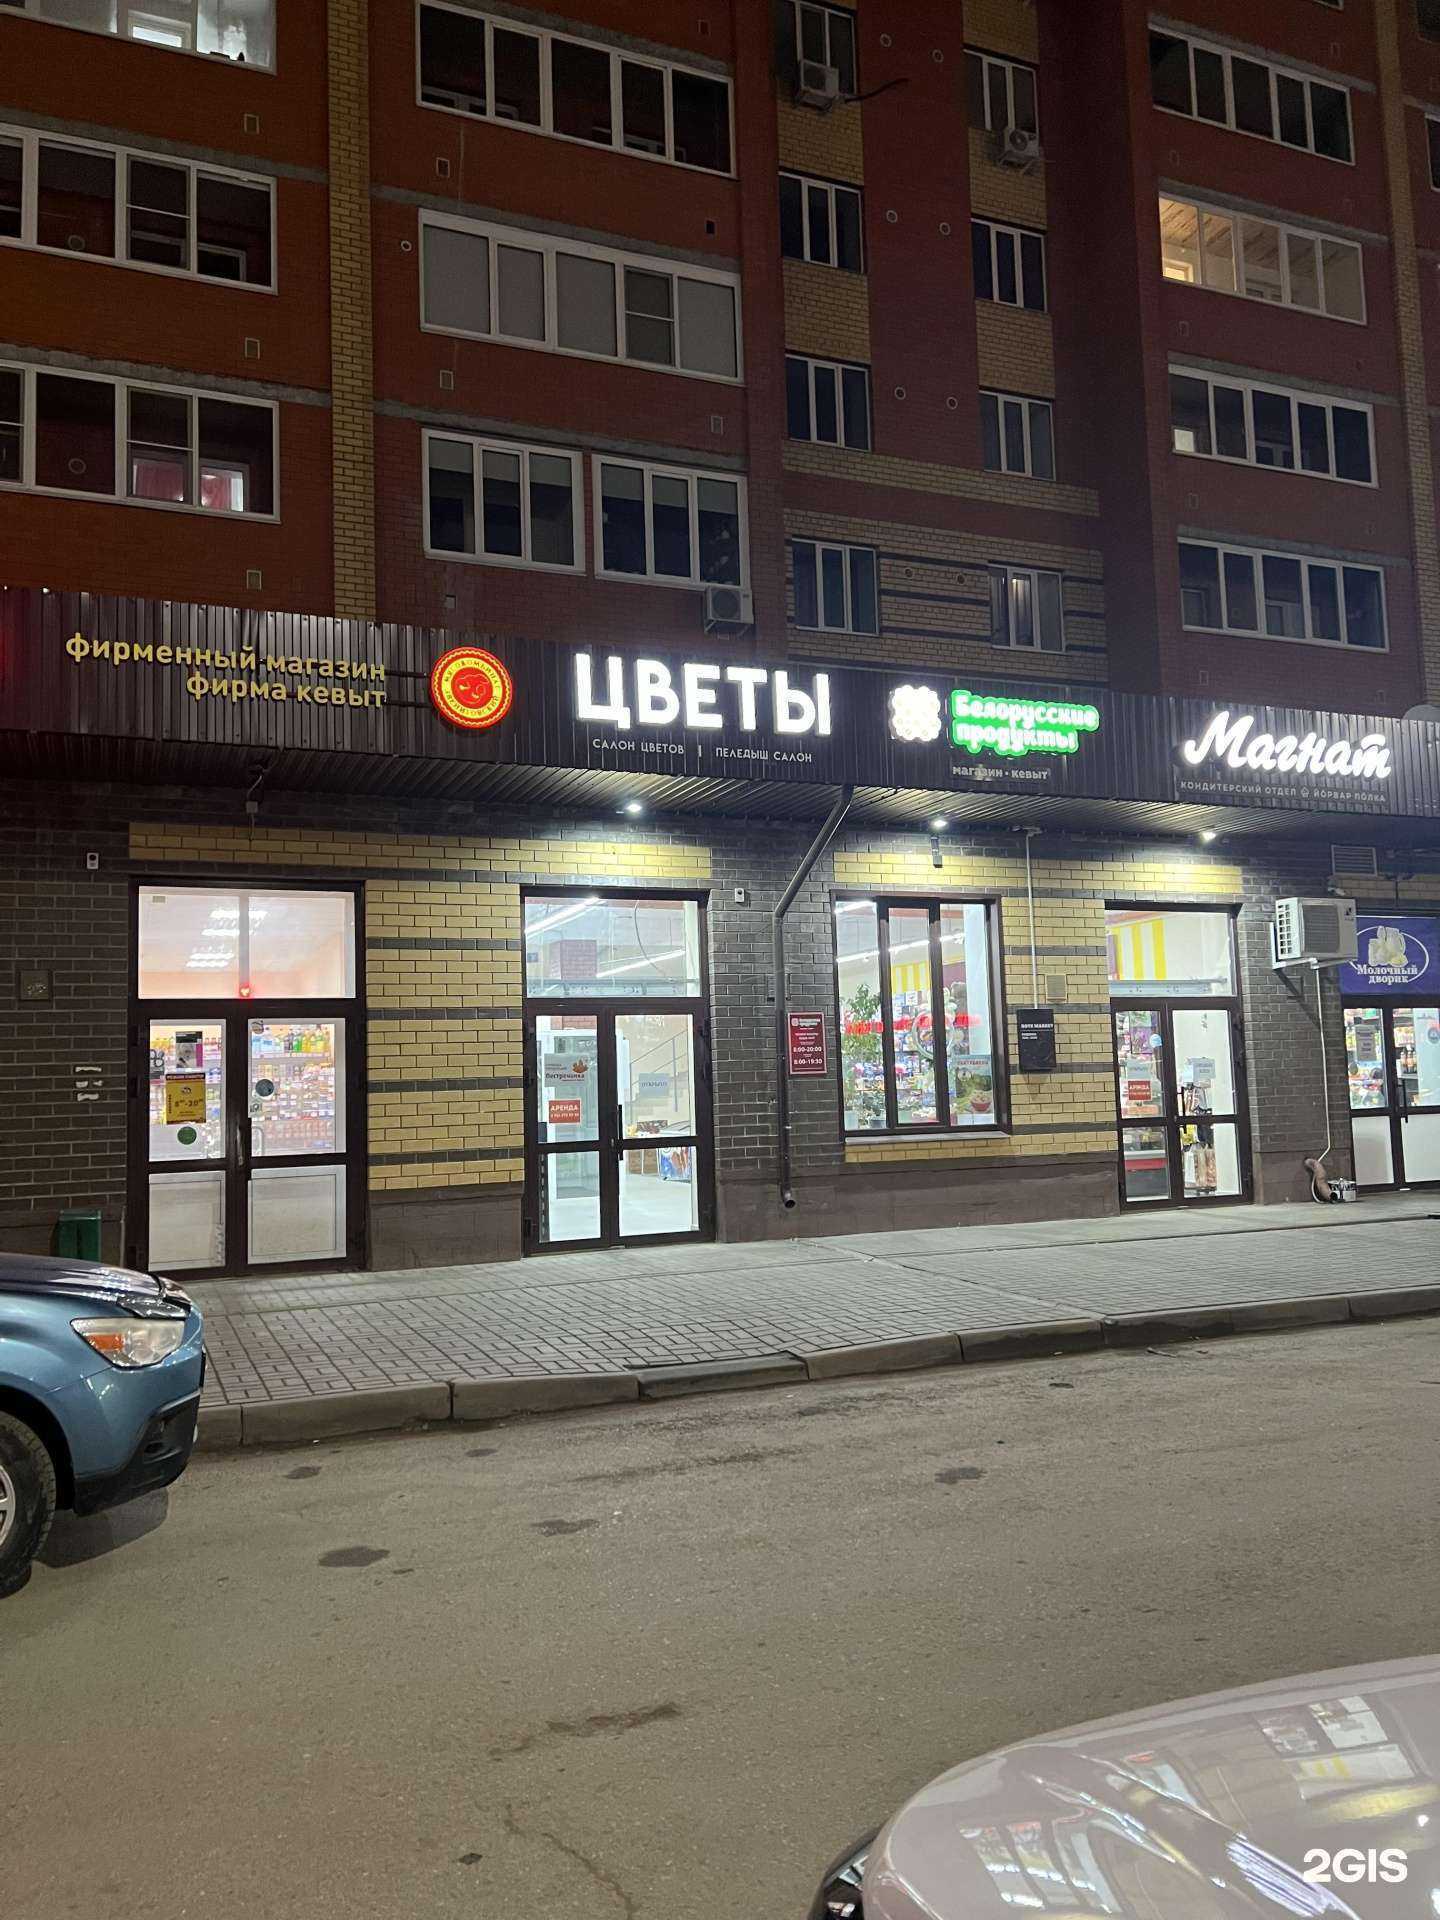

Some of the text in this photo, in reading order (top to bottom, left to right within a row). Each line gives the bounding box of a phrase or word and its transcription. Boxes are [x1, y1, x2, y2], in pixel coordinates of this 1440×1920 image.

[65, 631, 386, 682] фирменный магазин
[186, 670, 387, 708] фирма кевыт
[574, 651, 832, 737] ЦВЕТЫ
[953, 692, 1098, 729] Белорусские
[592, 738, 685, 755] САЛОН ЦВЕТОВ
[954, 723, 1078, 752] продукты
[1184, 709, 1393, 779] Магнат
[715, 747, 813, 762] ПЕЛЕДЫШ САЛОН
[952, 766, 1049, 780] магазин кевыт
[1180, 781, 1262, 794] КОНДИТЕРСКИЙ
[1357, 963, 1418, 976] Молочный
[1368, 975, 1409, 986] дворик
